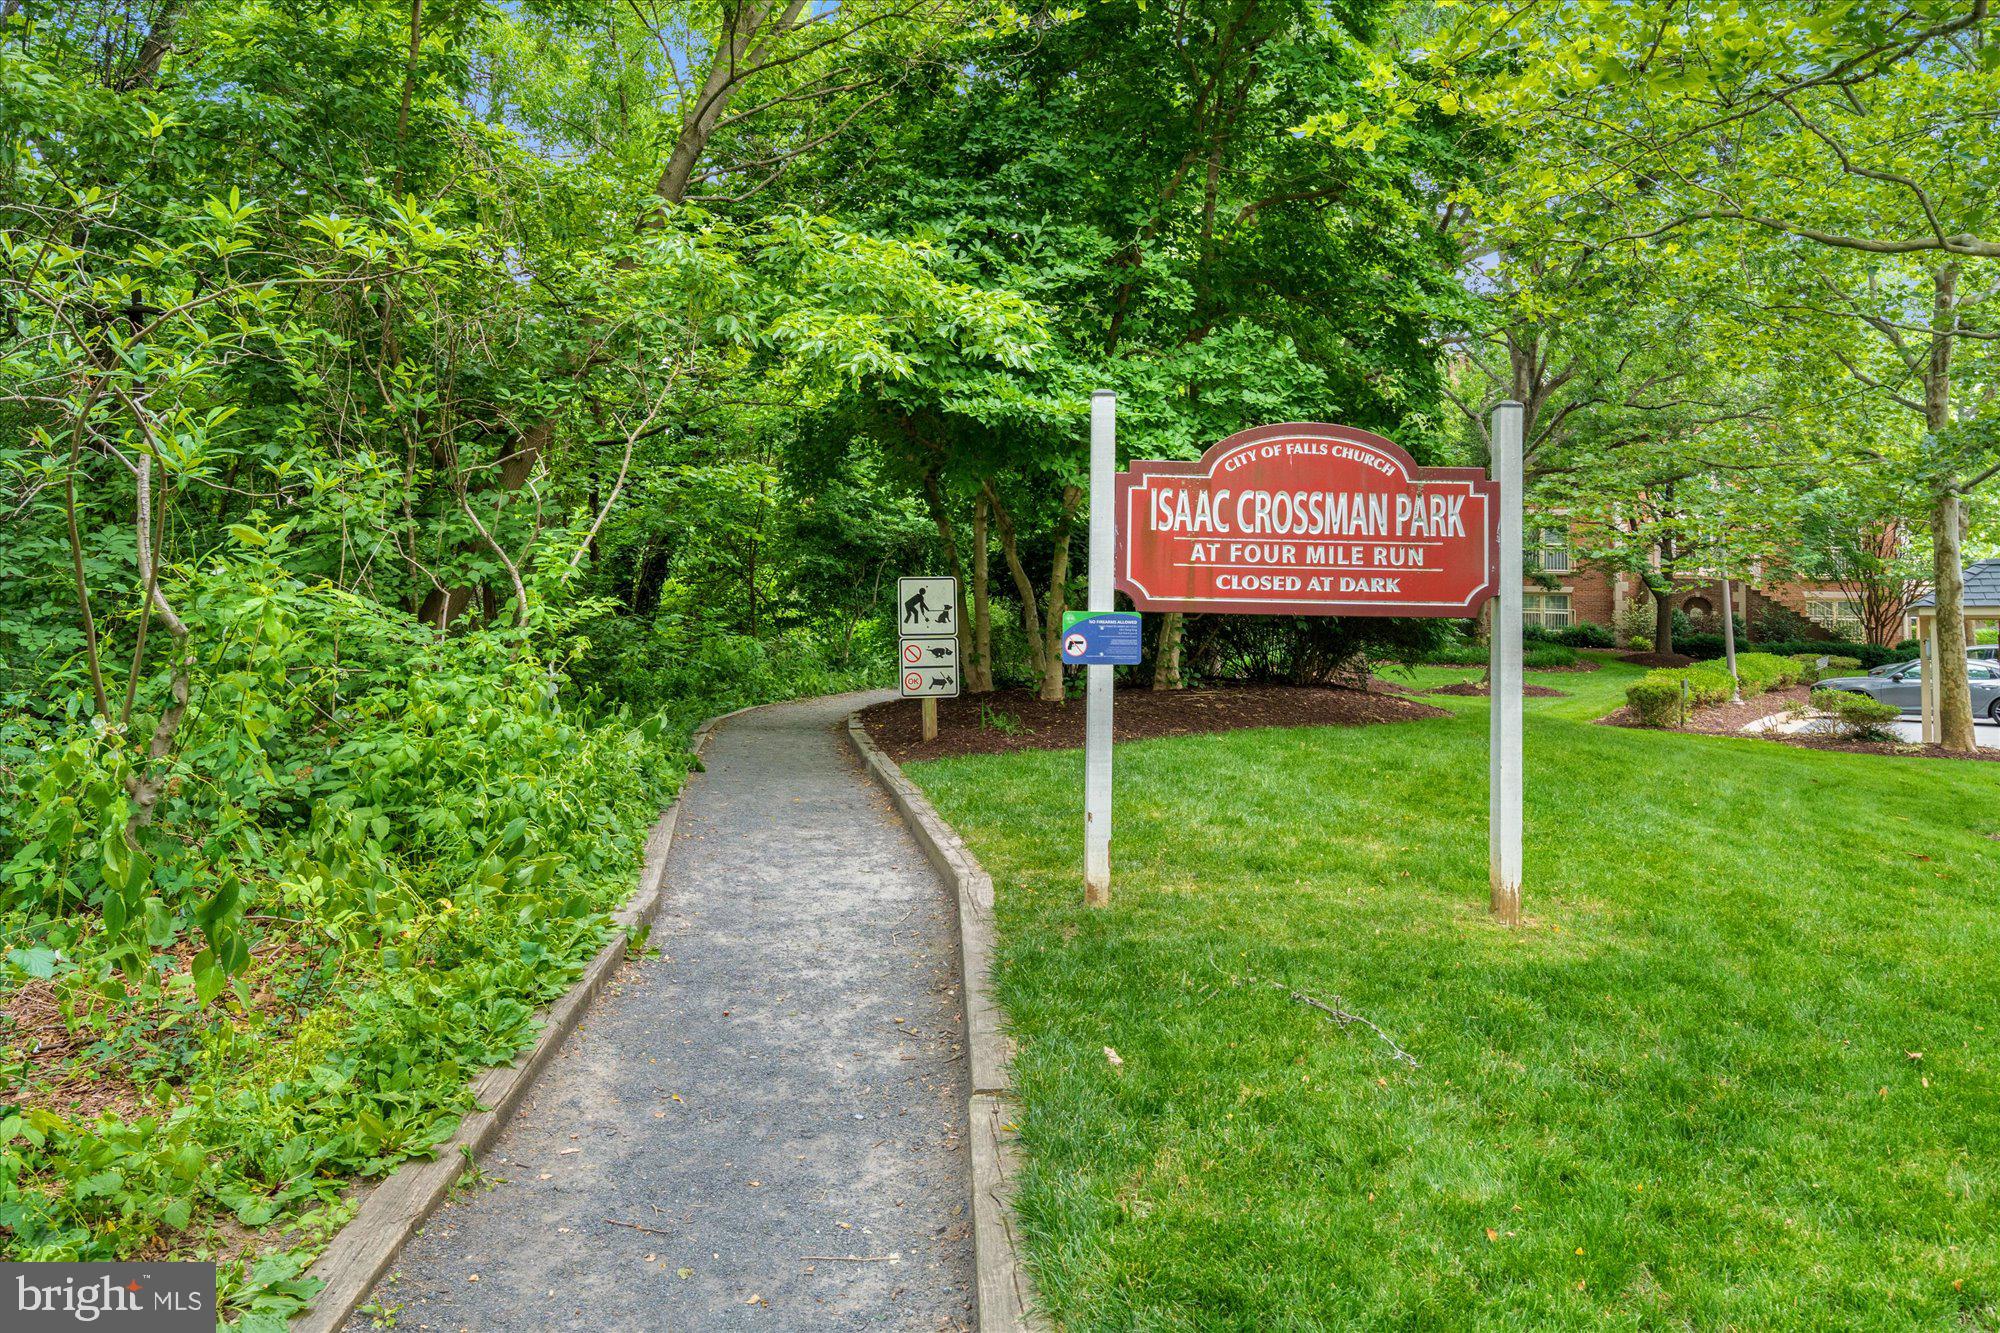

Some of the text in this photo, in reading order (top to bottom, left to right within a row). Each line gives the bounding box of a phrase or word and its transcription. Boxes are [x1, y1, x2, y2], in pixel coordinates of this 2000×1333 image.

[1225, 443, 1396, 477] CITY OF FALLS CHURCH
[1150, 488, 1466, 537] ISAAC CROSSMAN PARK
[1191, 543, 1424, 566] AT FOUR MILE RUN
[1216, 575, 1401, 593] CLOSED AT DARK
